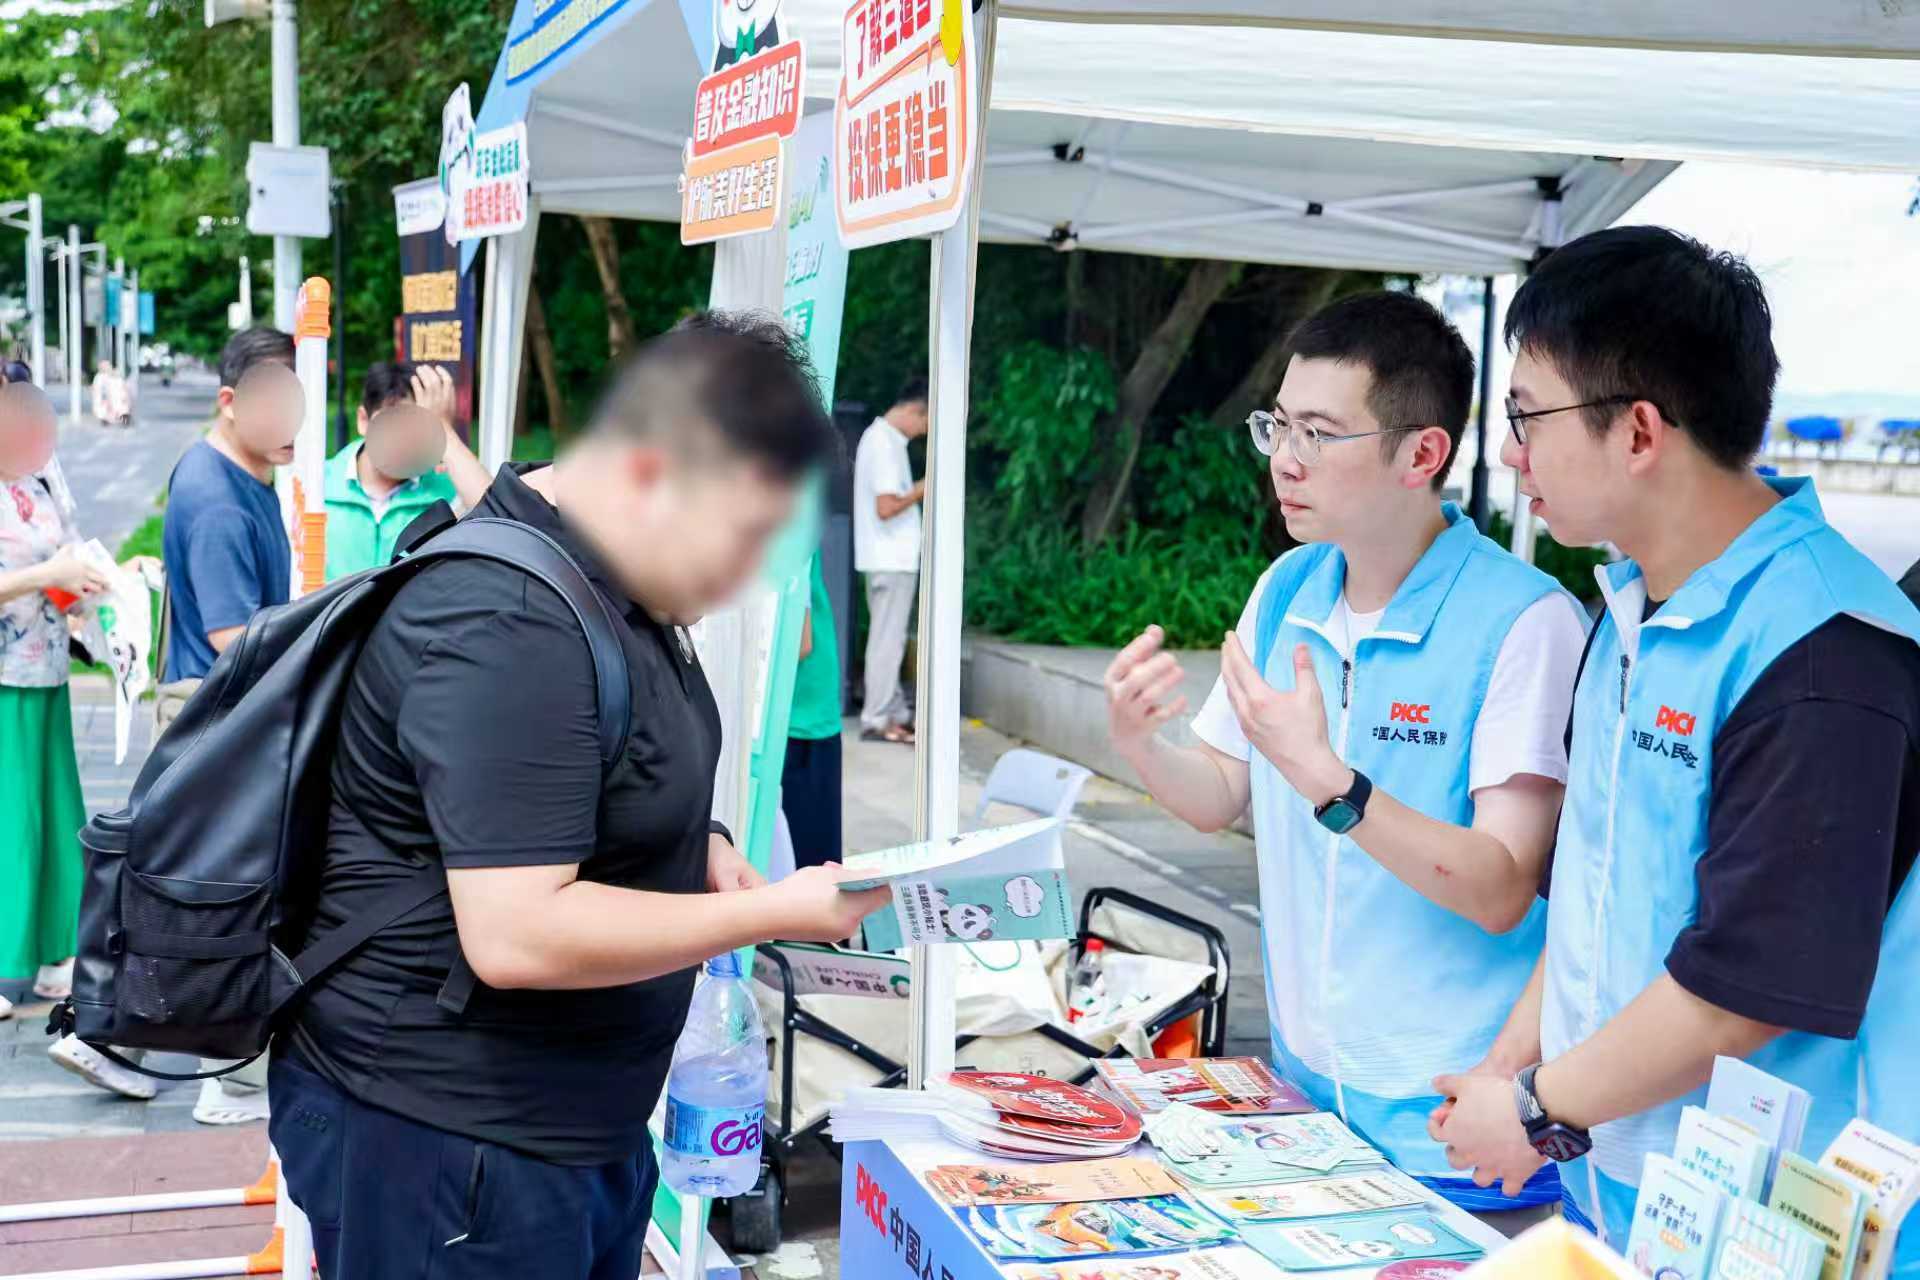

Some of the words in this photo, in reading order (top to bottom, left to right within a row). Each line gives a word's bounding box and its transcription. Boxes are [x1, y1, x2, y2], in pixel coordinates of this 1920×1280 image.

[696, 56, 797, 144] 普及金融知识
[848, 80, 948, 203] 投保更稳当
[686, 158, 777, 224] 护航美好生活
[1390, 702, 1431, 724] PICC
[856, 1160, 887, 1239] PICC
